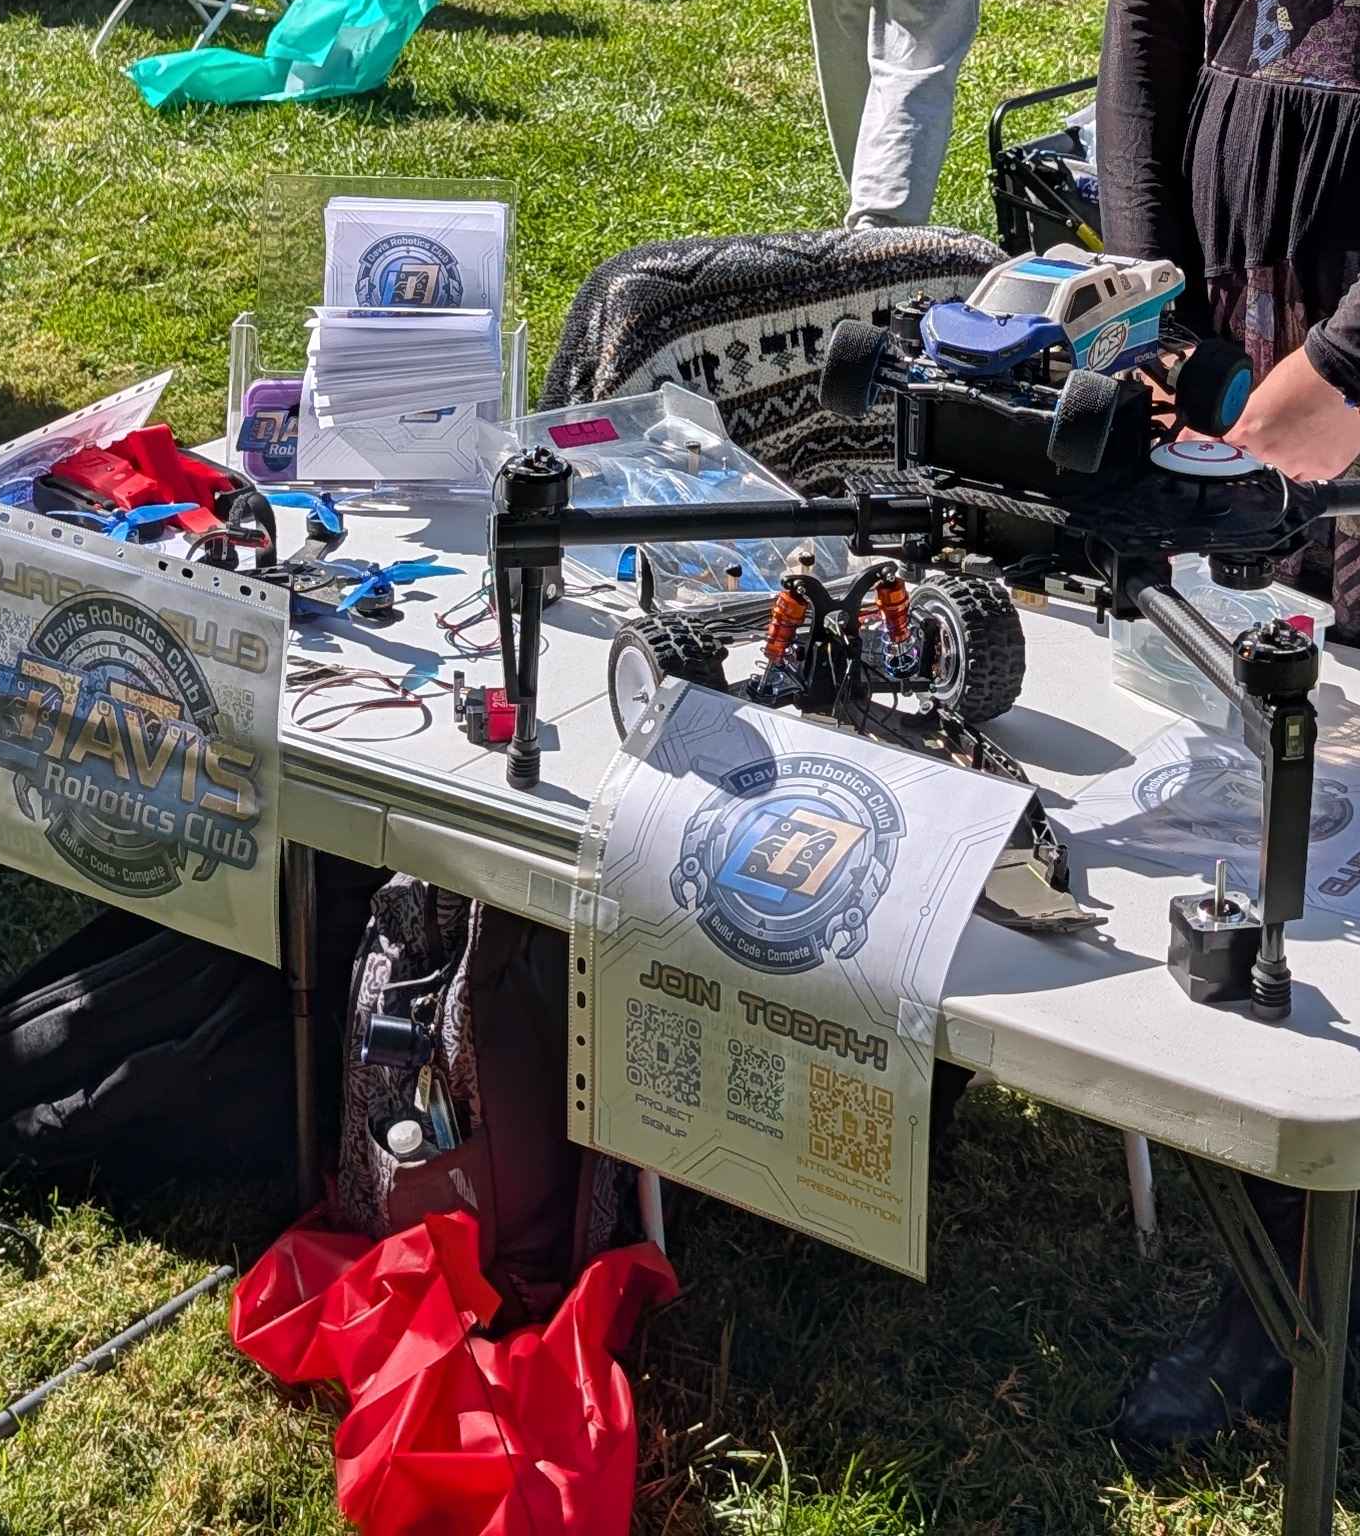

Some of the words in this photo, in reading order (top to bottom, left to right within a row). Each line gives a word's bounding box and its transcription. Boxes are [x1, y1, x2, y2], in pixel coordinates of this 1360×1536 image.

[367, 243, 389, 262] Davis
[390, 236, 431, 249] Robotics
[431, 245, 450, 264] Club
[43, 611, 88, 656] Davis
[88, 604, 166, 653] Robotics
[166, 648, 201, 704] Club
[43, 760, 177, 835] Robotics
[183, 811, 255, 862] Club
[737, 760, 794, 789] Davis
[795, 757, 873, 801] Robotics
[866, 792, 896, 830] Club
[59, 827, 84, 858] Build
[89, 854, 116, 878] Code
[121, 864, 167, 886] Compete
[709, 913, 735, 943] Build
[736, 940, 761, 961] Code
[765, 943, 812, 966] Compete
[640, 960, 721, 1012] JOIN
[738, 990, 889, 1072] TODAY!
[634, 1093, 695, 1125] PROJECT
[640, 1113, 688, 1139] SIGNUP
[725, 1108, 784, 1141] DISCORD
[795, 1173, 903, 1225] PRESENTATION
[796, 1154, 904, 1206] INTRODUCTORY
